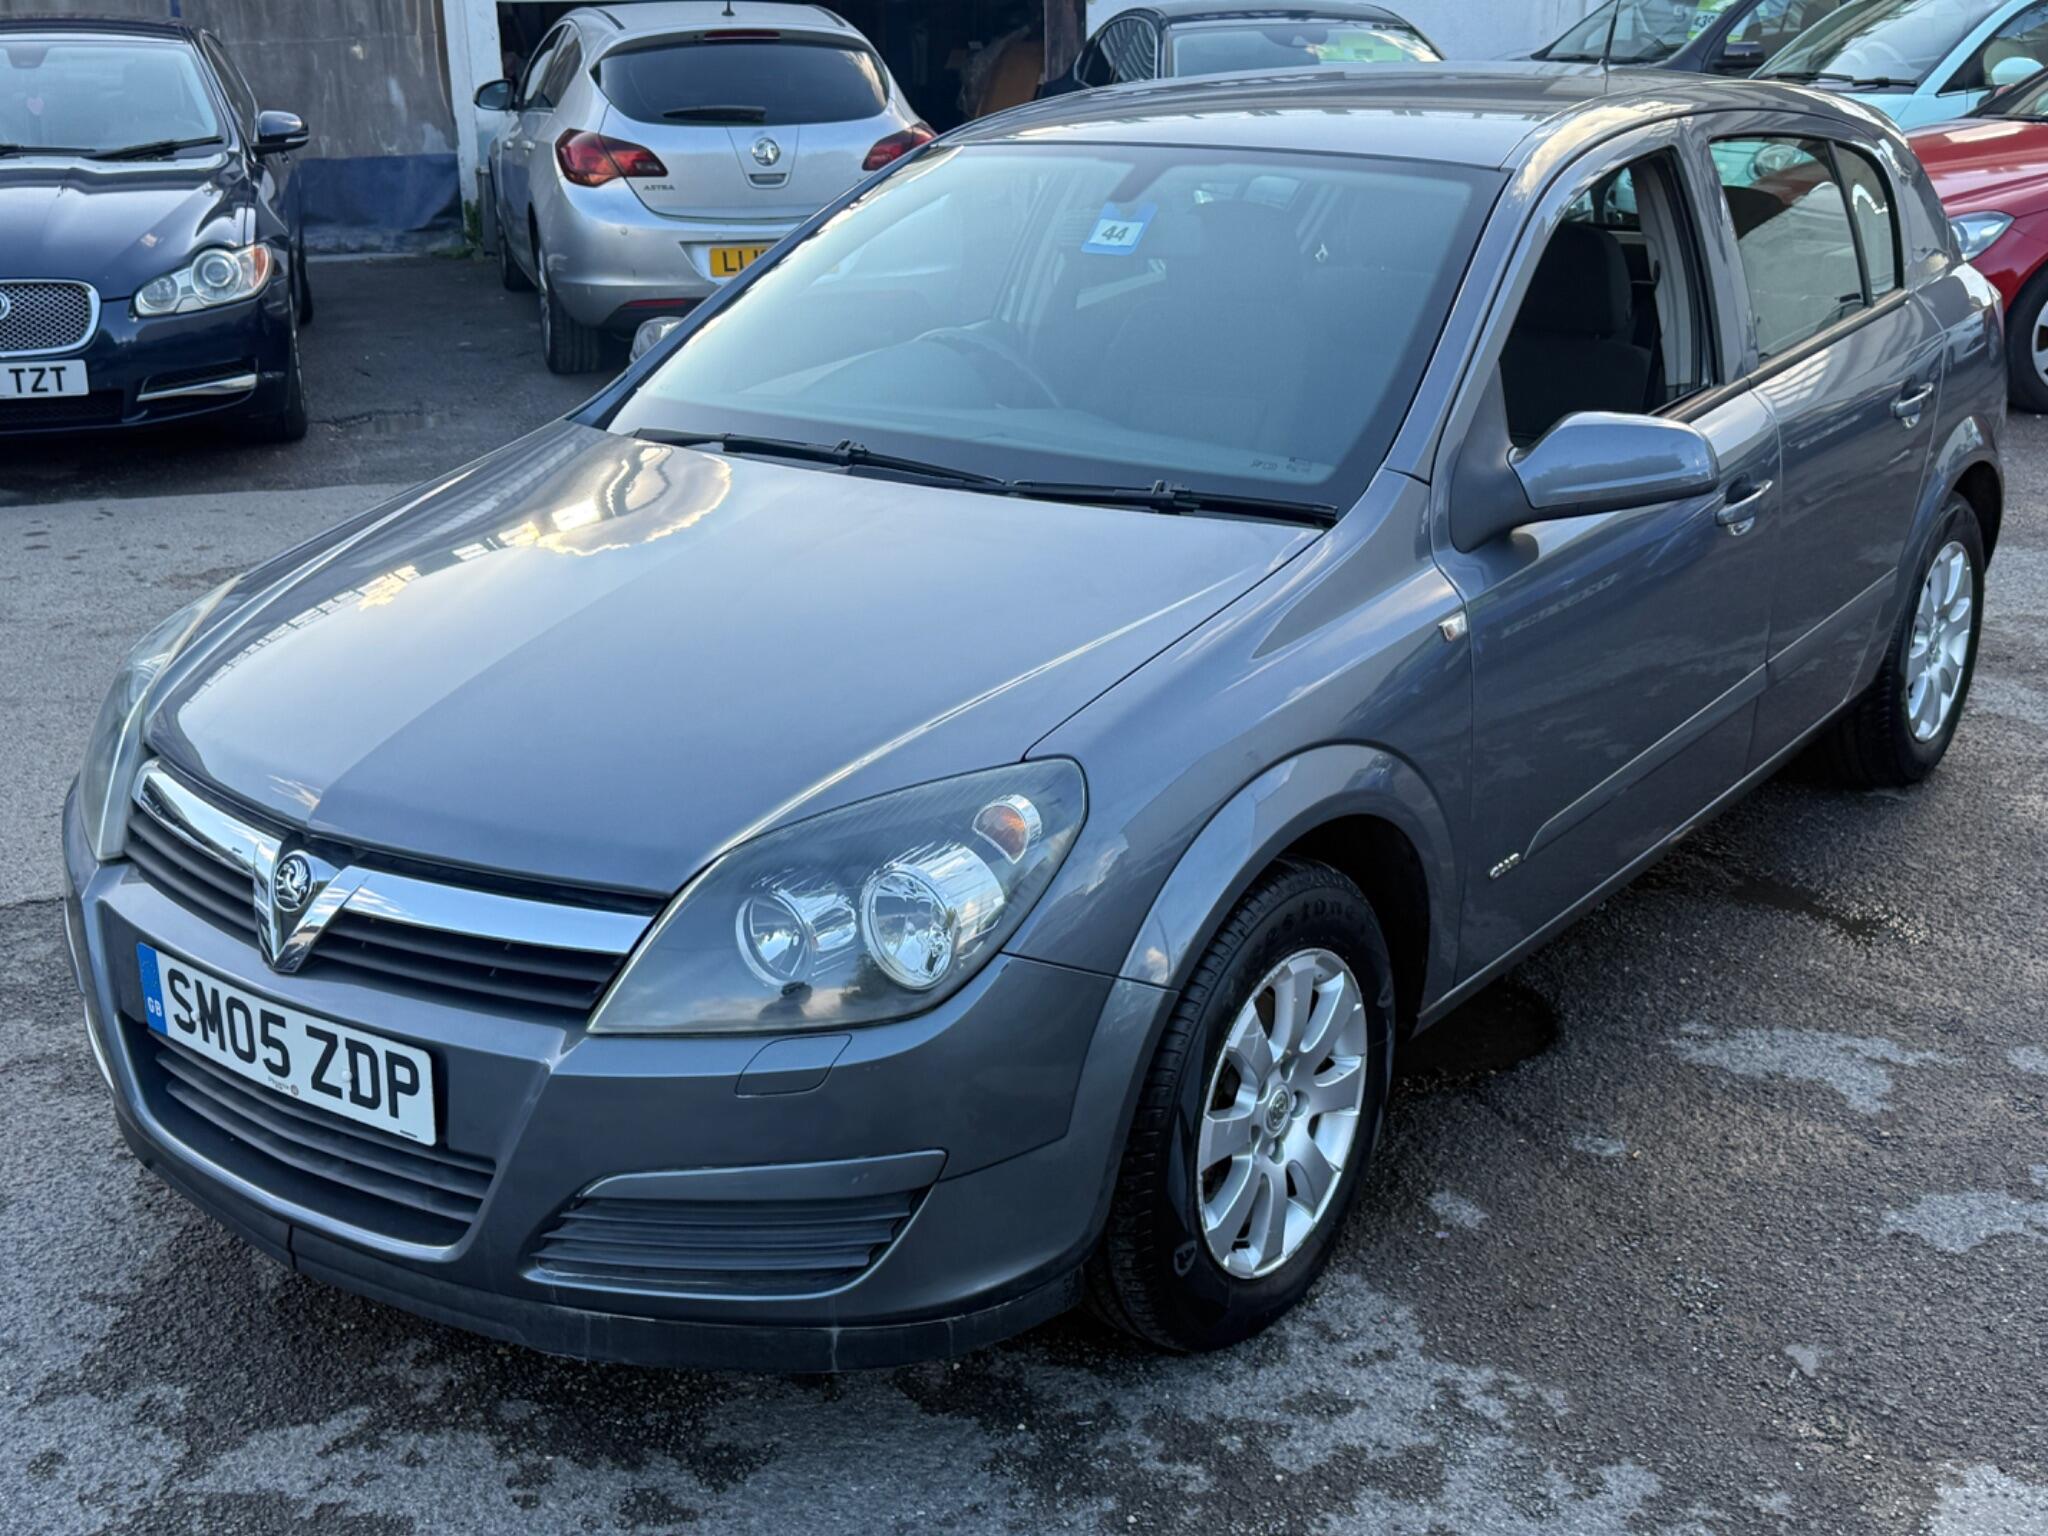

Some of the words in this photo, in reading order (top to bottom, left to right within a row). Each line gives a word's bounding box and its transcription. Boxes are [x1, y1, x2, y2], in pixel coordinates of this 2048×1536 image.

[1101, 225, 1129, 242] 44
[8, 366, 66, 394] TZT
[147, 996, 163, 1018] GB
[167, 968, 291, 1079] SM05
[305, 1024, 420, 1119] ZDP
